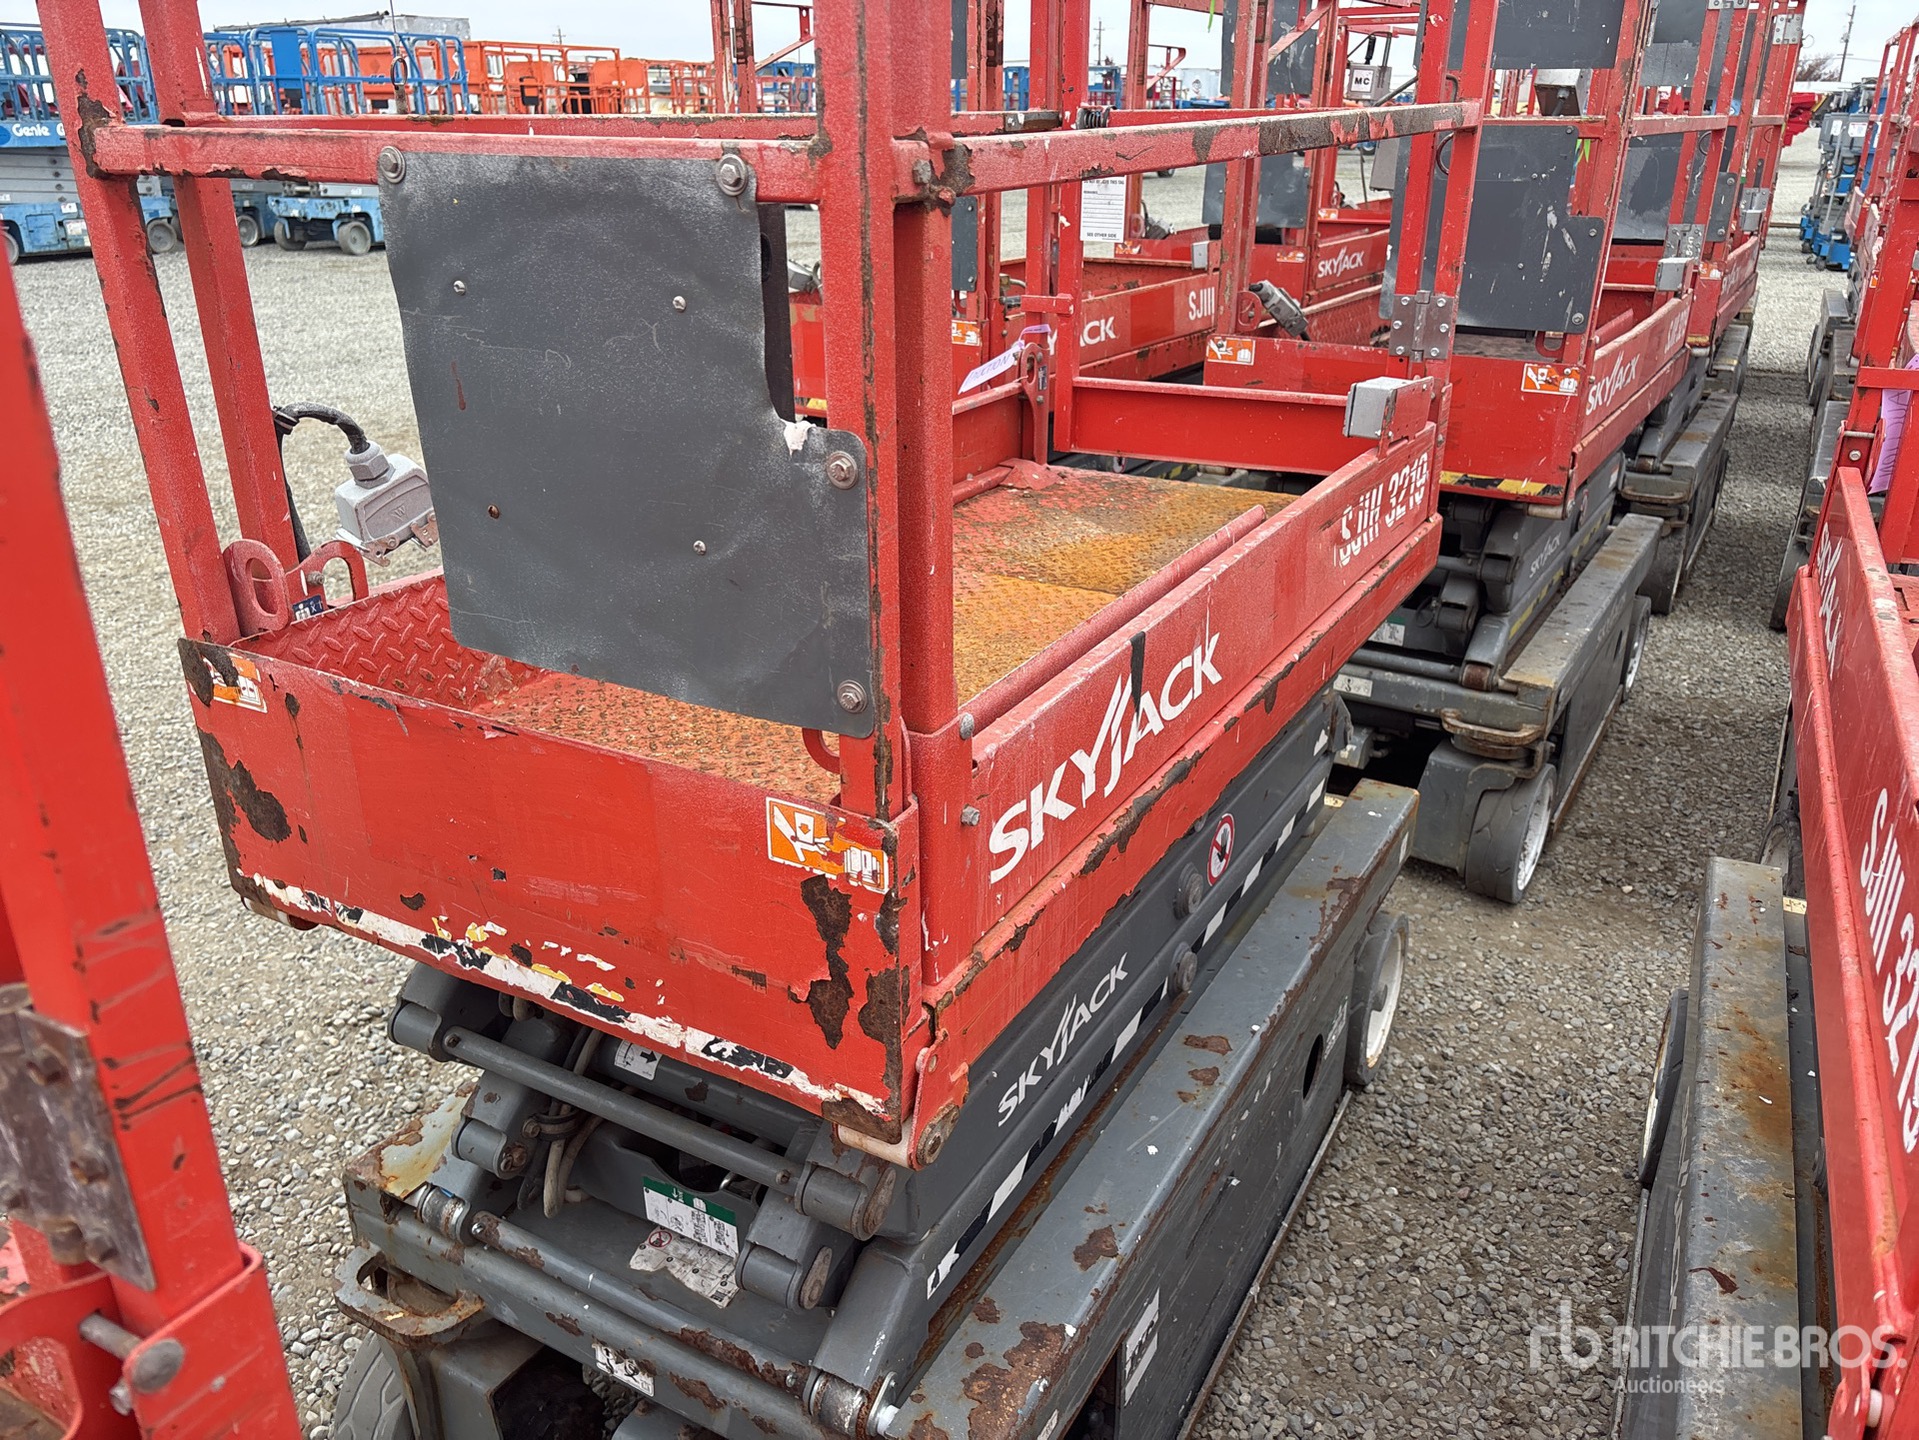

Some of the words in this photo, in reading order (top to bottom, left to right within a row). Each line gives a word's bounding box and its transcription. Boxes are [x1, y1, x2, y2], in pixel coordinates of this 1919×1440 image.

[1354, 77, 1370, 85] MC
[12, 123, 50, 137] Genie
[1317, 246, 1365, 278] SKYJACK
[1585, 350, 1640, 416] SKYJACK
[1529, 531, 1562, 578] SKYJACK
[988, 632, 1223, 885] SKYJACK
[998, 952, 1129, 1127] SKYJACK
